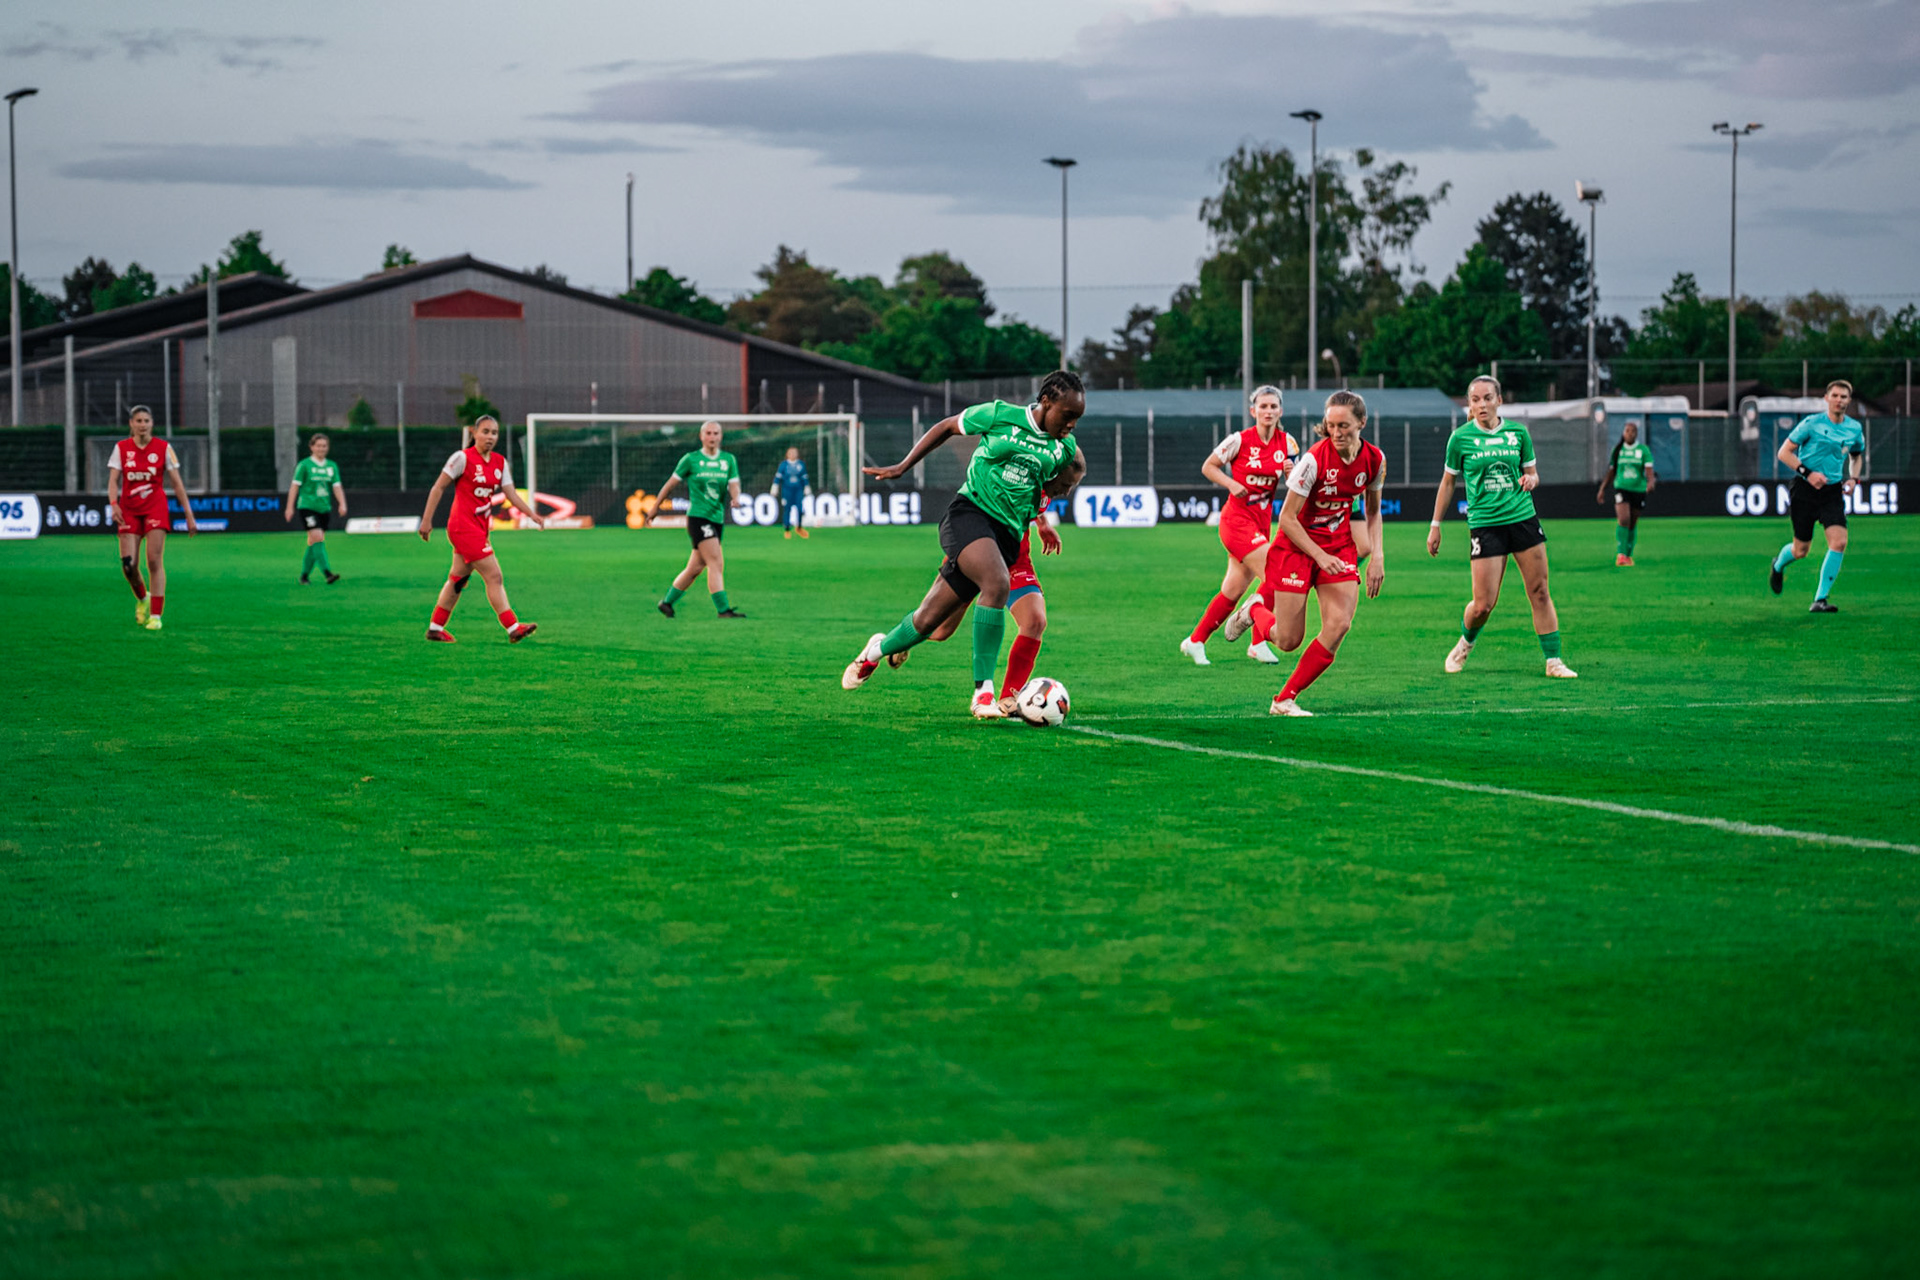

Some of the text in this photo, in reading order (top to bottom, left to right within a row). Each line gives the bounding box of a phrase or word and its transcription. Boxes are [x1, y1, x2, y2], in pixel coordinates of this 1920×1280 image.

[731, 492, 921, 526] GO MOBILE!
[1161, 497, 1176, 518] à
[1178, 496, 1209, 518] vie
[1726, 484, 1768, 516] GO
[46, 505, 61, 527] à
[65, 504, 100, 527] vie
